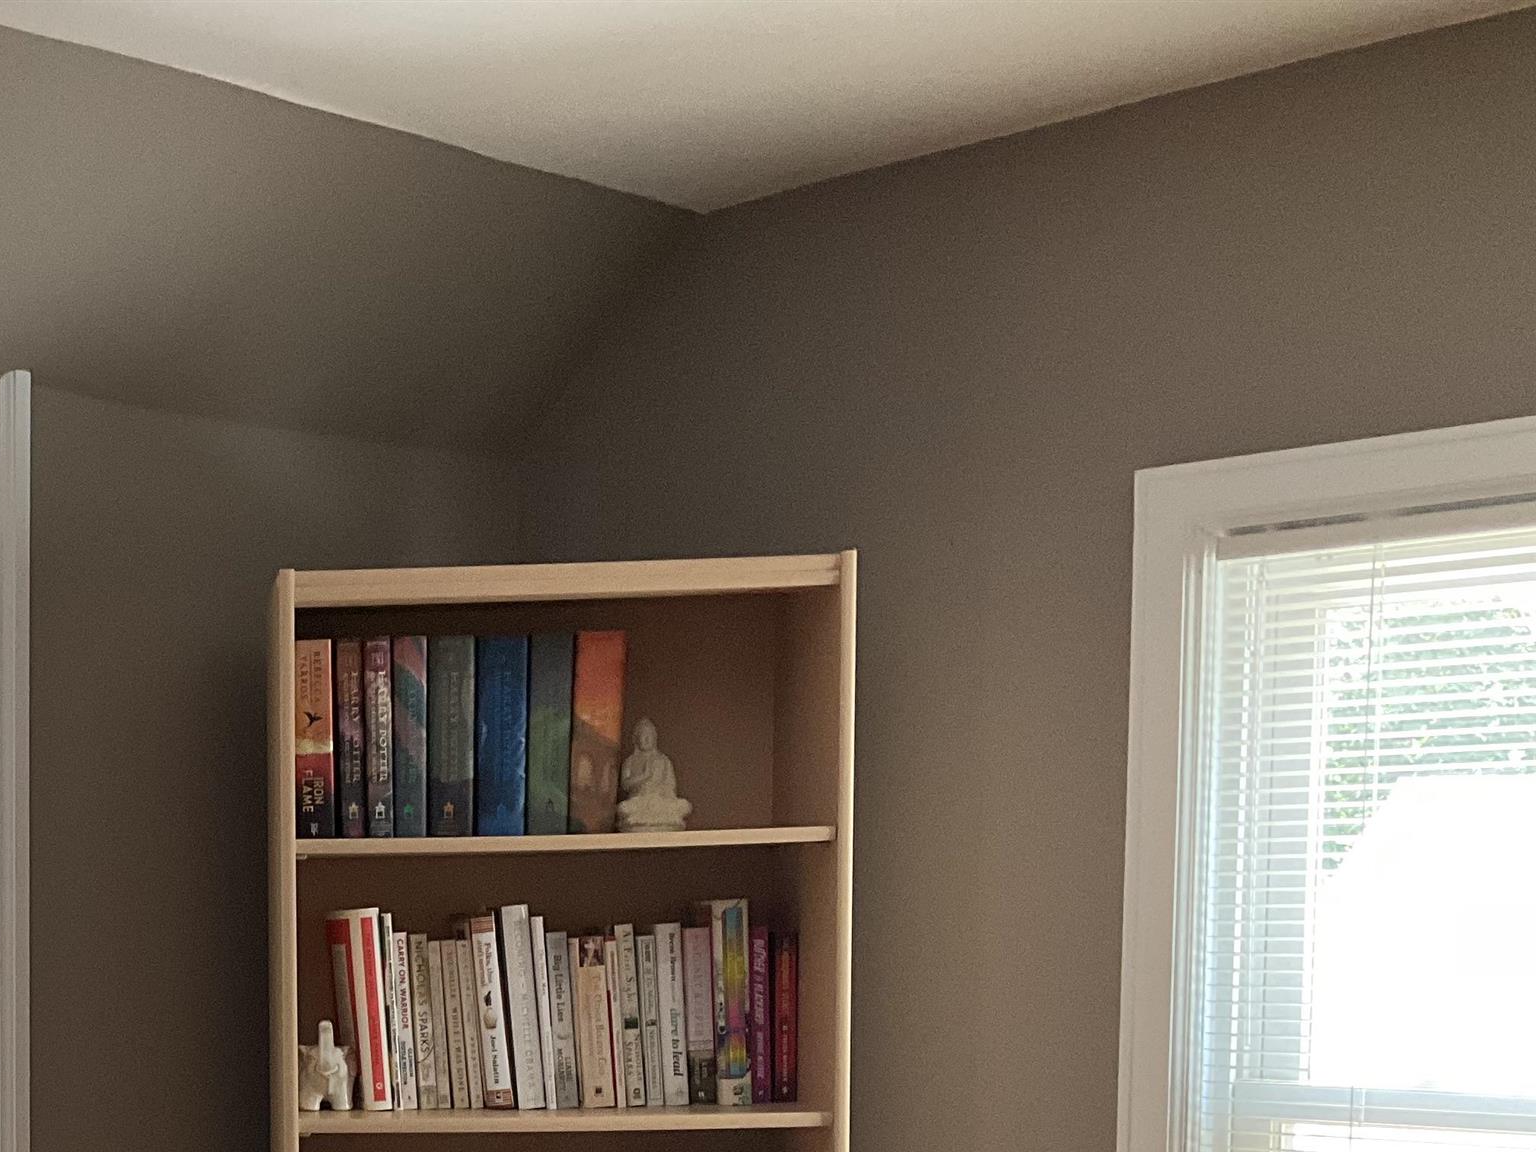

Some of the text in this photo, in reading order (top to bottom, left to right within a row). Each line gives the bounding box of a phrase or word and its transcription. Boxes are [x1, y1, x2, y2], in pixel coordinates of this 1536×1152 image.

[377, 671, 388, 724] HARRY
[351, 671, 361, 783] HARRY POTTER
[379, 729, 388, 783] POTTER
[302, 770, 313, 813] FLAME
[313, 778, 323, 805] IRON
[396, 938, 404, 967] CARRY
[400, 988, 409, 1030] WARRIOR
[414, 940, 426, 1006] NICHOLAS
[552, 955, 565, 1022] Big Little Lies
[418, 1011, 430, 1054] SPARKS
[451, 1007, 460, 1035] WHILE
[670, 1008, 683, 1077] dare to lead
[455, 1046, 463, 1065] WAS
[456, 1068, 465, 1092] GONE
[489, 1035, 500, 1084] Joel Salatin
[625, 1041, 633, 1076] SPARKS
